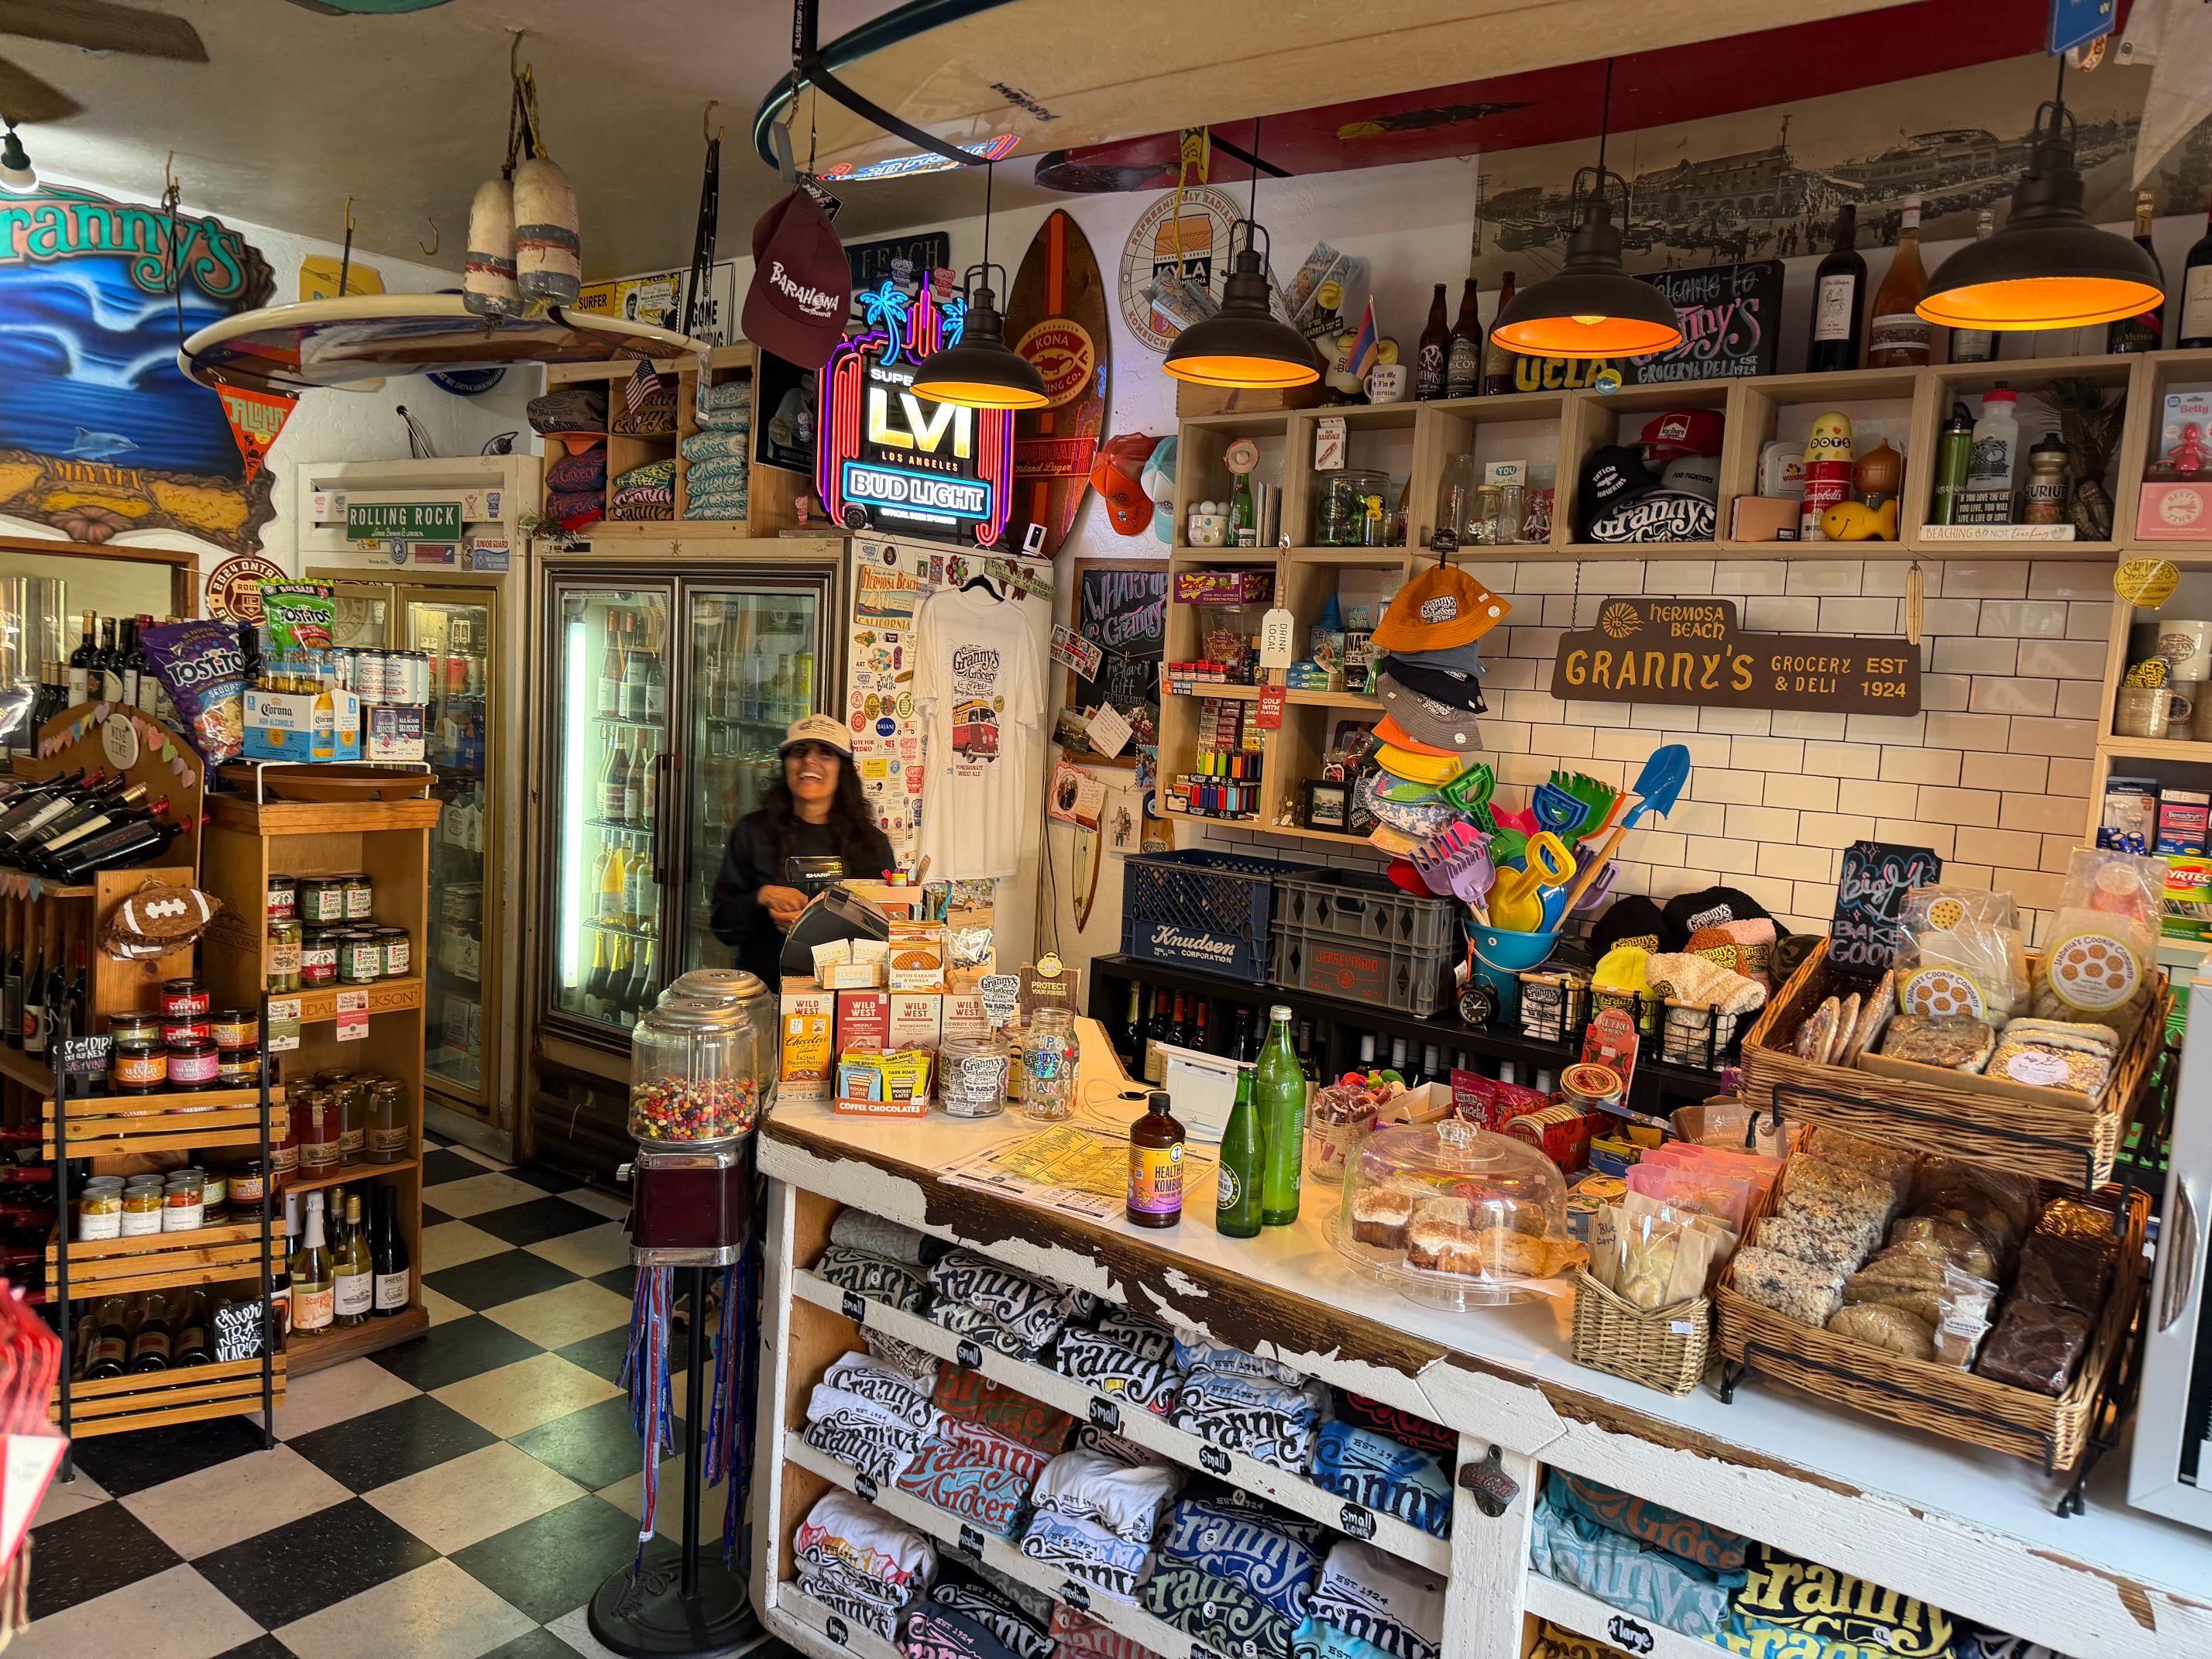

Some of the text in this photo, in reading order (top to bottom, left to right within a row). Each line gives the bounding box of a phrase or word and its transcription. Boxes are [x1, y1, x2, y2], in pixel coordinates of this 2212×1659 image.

[0, 204, 242, 296] ranny's
[579, 294, 607, 311] SURFER
[1035, 334, 1069, 350] KONA
[870, 368, 914, 386] SUPE
[1516, 357, 1609, 392] UCLA
[868, 387, 972, 459] LVI
[1810, 437, 1851, 449] DOTS
[881, 451, 958, 472] LOS ANGELES
[1498, 466, 1515, 476] YOU
[1592, 465, 1616, 483] TAYLOR
[851, 469, 984, 511] BUD LIGHT
[1597, 477, 1626, 498] HAWKINS
[350, 507, 455, 526] ROLLING ROCK
[862, 567, 918, 591] HERMOSA BEACH
[1650, 603, 1725, 623] HERMOSA
[857, 617, 911, 630] CALIFORNIA
[1670, 622, 1726, 641] BEACH
[1267, 624, 1276, 651] LOCAL
[1279, 623, 1287, 653] DRINK
[1565, 644, 1754, 691] GRANNY'S
[1771, 655, 1852, 674] GROCERY
[1867, 658, 1908, 675] EST
[1111, 678, 1135, 695] Gift
[1775, 676, 1836, 693] & DELI
[1861, 681, 1907, 698] 1924
[261, 701, 293, 717] Corona
[2168, 869, 2212, 883] YRTEC
[1151, 925, 1238, 957] Knudsen
[1181, 950, 1232, 963] CORPORATION
[1317, 950, 1378, 972] JERSEYMAID
[1925, 970, 1955, 981] Cookie
[1031, 981, 1067, 989] PROTECT
[851, 1008, 877, 1017] WEST
[852, 1001, 875, 1009] WILD
[957, 1001, 979, 1009] WILD
[1597, 1017, 1630, 1031] RETRO
[839, 1102, 920, 1114] COFFEE CHOCOLATES
[219, 1331, 252, 1346] NEW
[1353, 1437, 1376, 1453] EST
[1341, 1509, 1372, 1530] Small
[967, 1582, 983, 1593] EST
[1335, 1574, 1389, 1606] EST 1924
[934, 1616, 974, 1645] EST 1924
